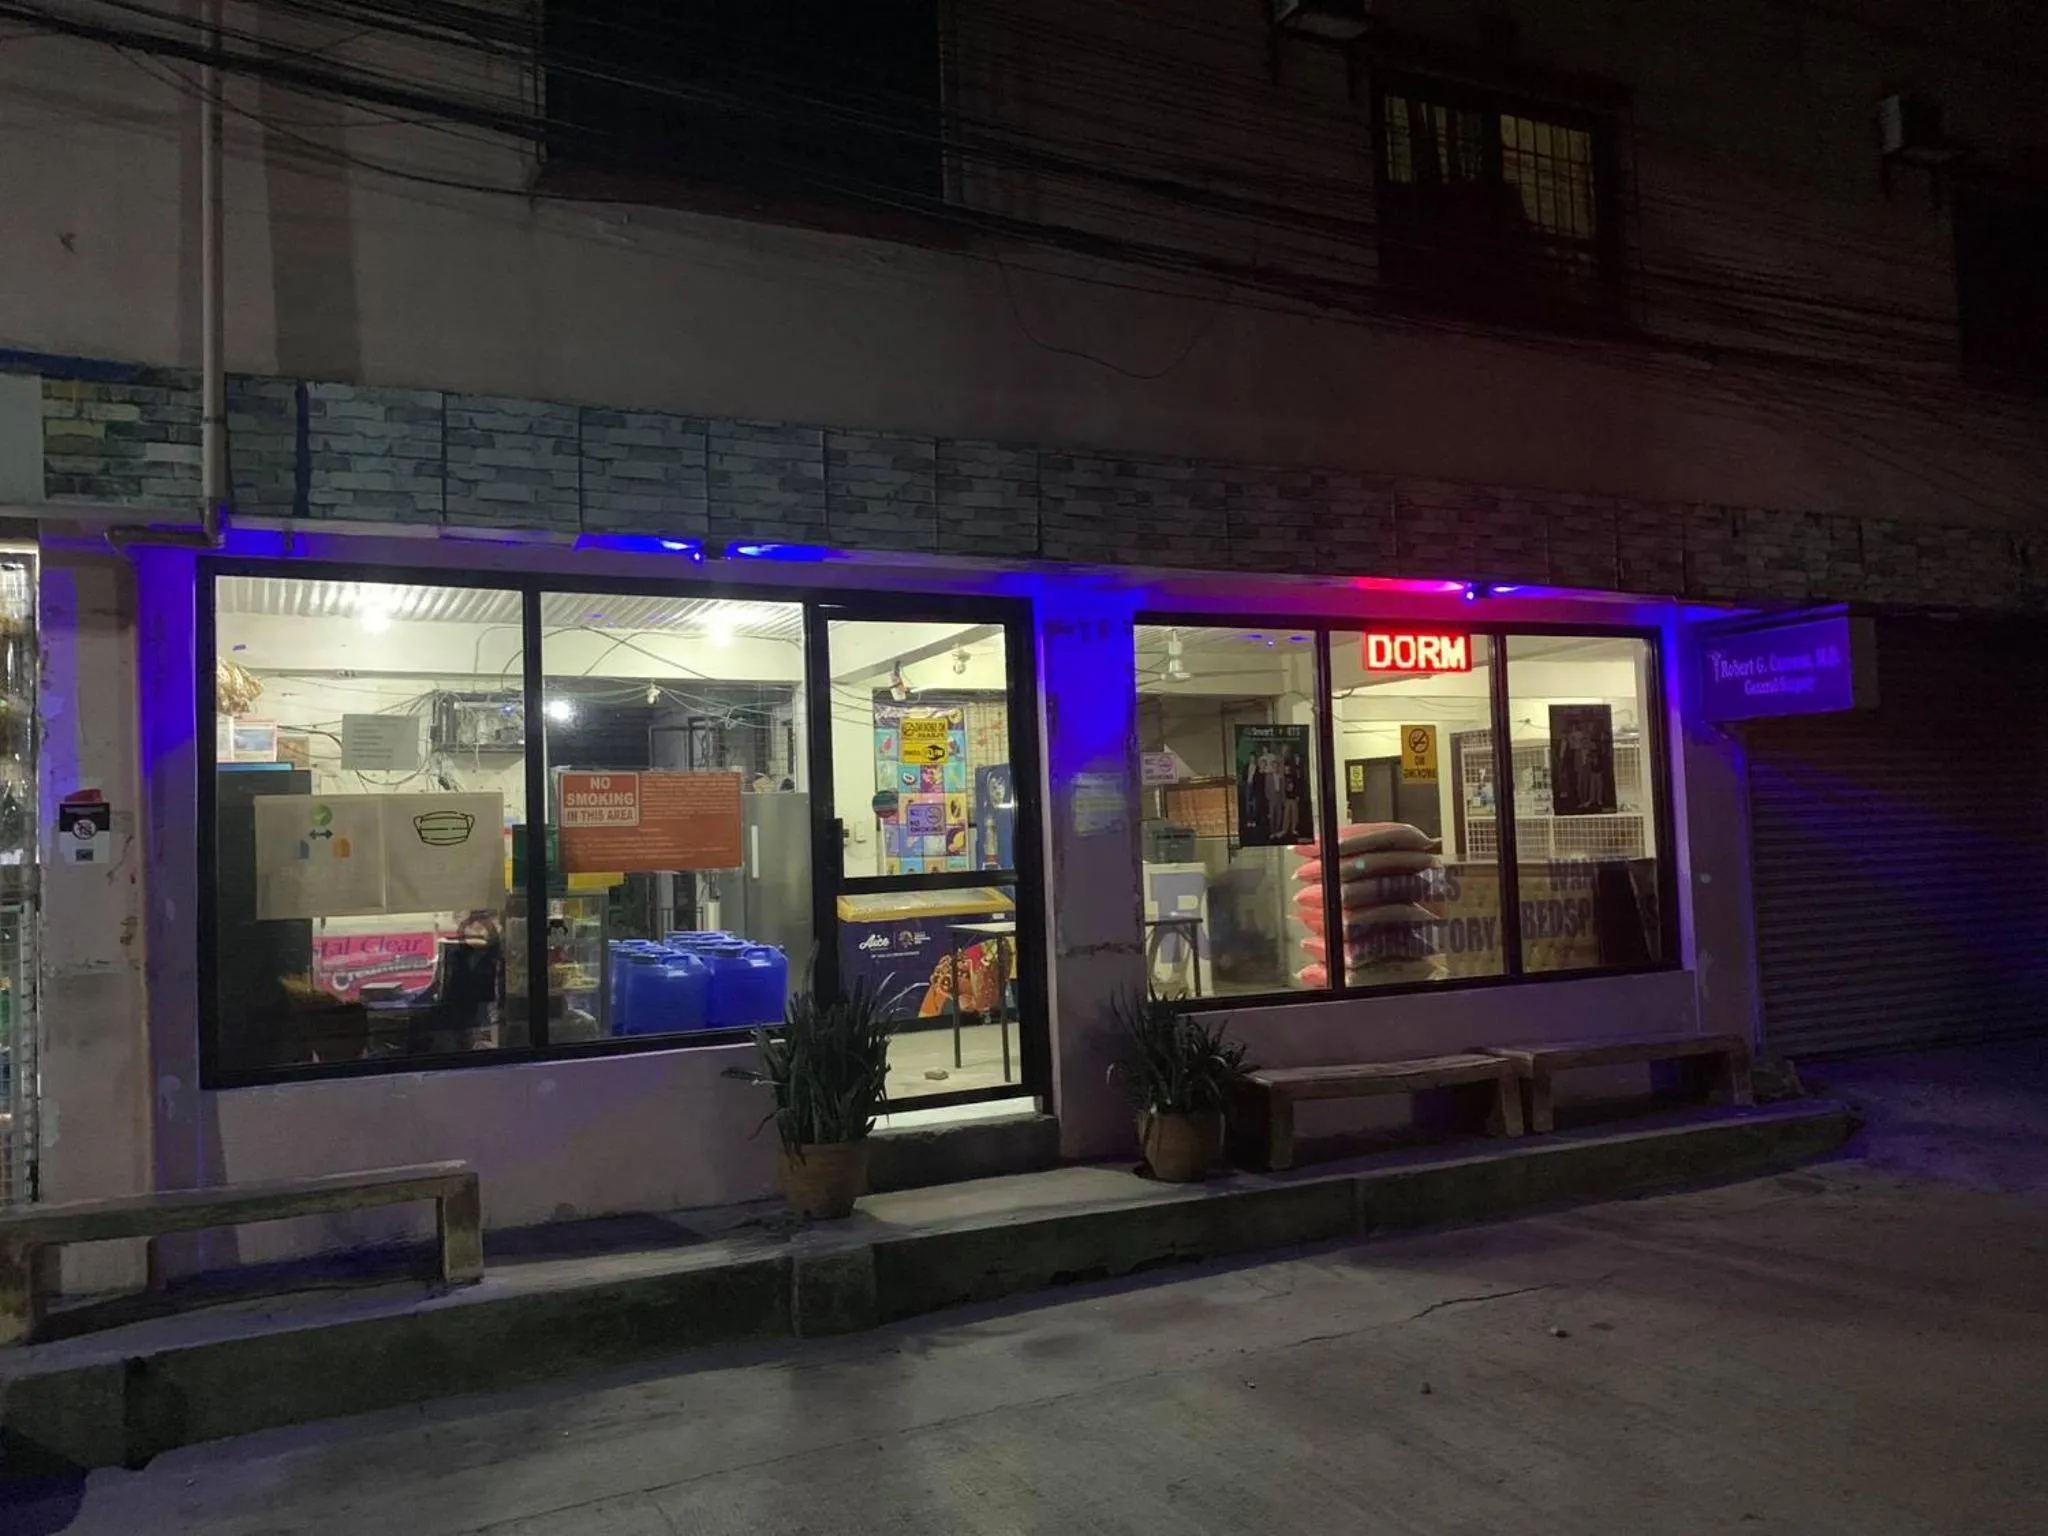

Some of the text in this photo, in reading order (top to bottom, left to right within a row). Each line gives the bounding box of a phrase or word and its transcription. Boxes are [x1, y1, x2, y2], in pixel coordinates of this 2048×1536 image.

[1367, 634, 1466, 670] DORM
[1720, 658, 1753, 678] Robert
[590, 776, 611, 790] NO
[566, 792, 635, 806] SMOKING
[567, 809, 634, 822] IN THIS AREA
[361, 934, 425, 954] Clear
